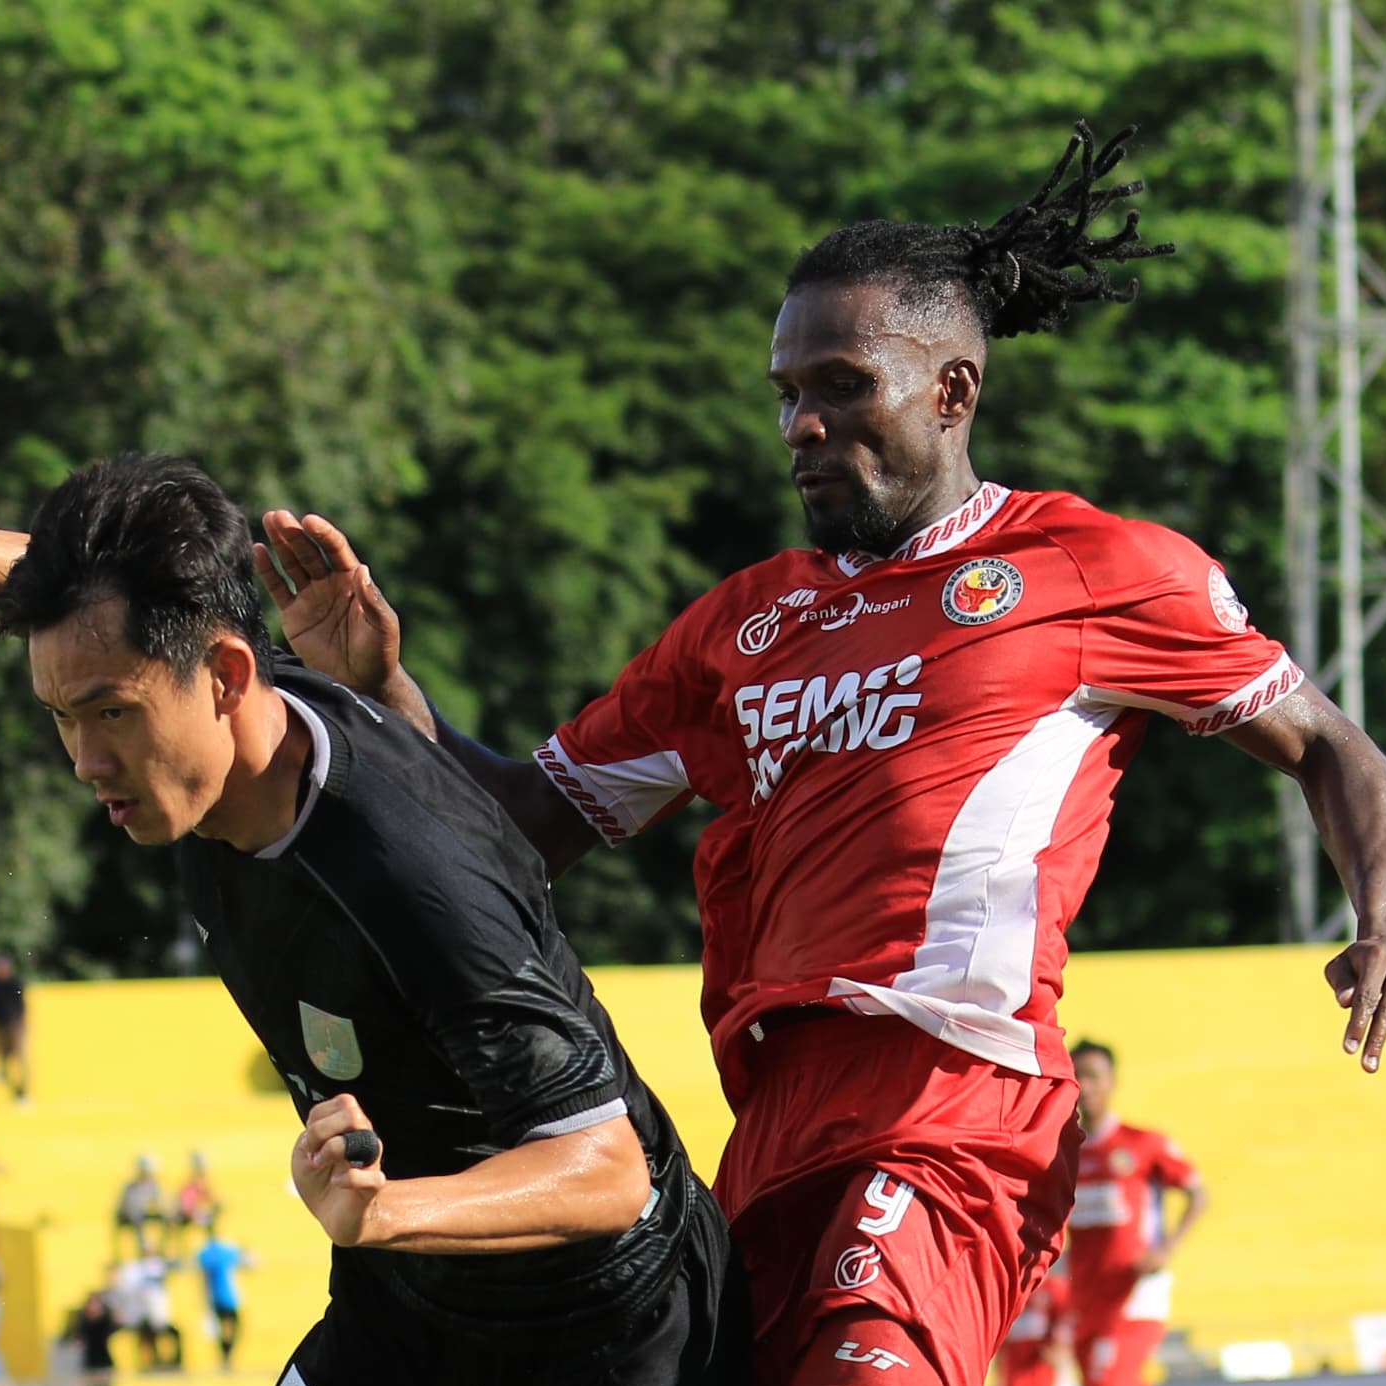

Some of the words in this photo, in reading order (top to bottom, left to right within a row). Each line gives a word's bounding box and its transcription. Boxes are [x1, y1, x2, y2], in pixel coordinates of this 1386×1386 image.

[948, 561, 978, 587] SEMEN
[982, 559, 1020, 580] PADANG
[862, 594, 912, 616] Nagari
[957, 604, 1011, 624] SUMATERA
[856, 1170, 916, 1237] 9
